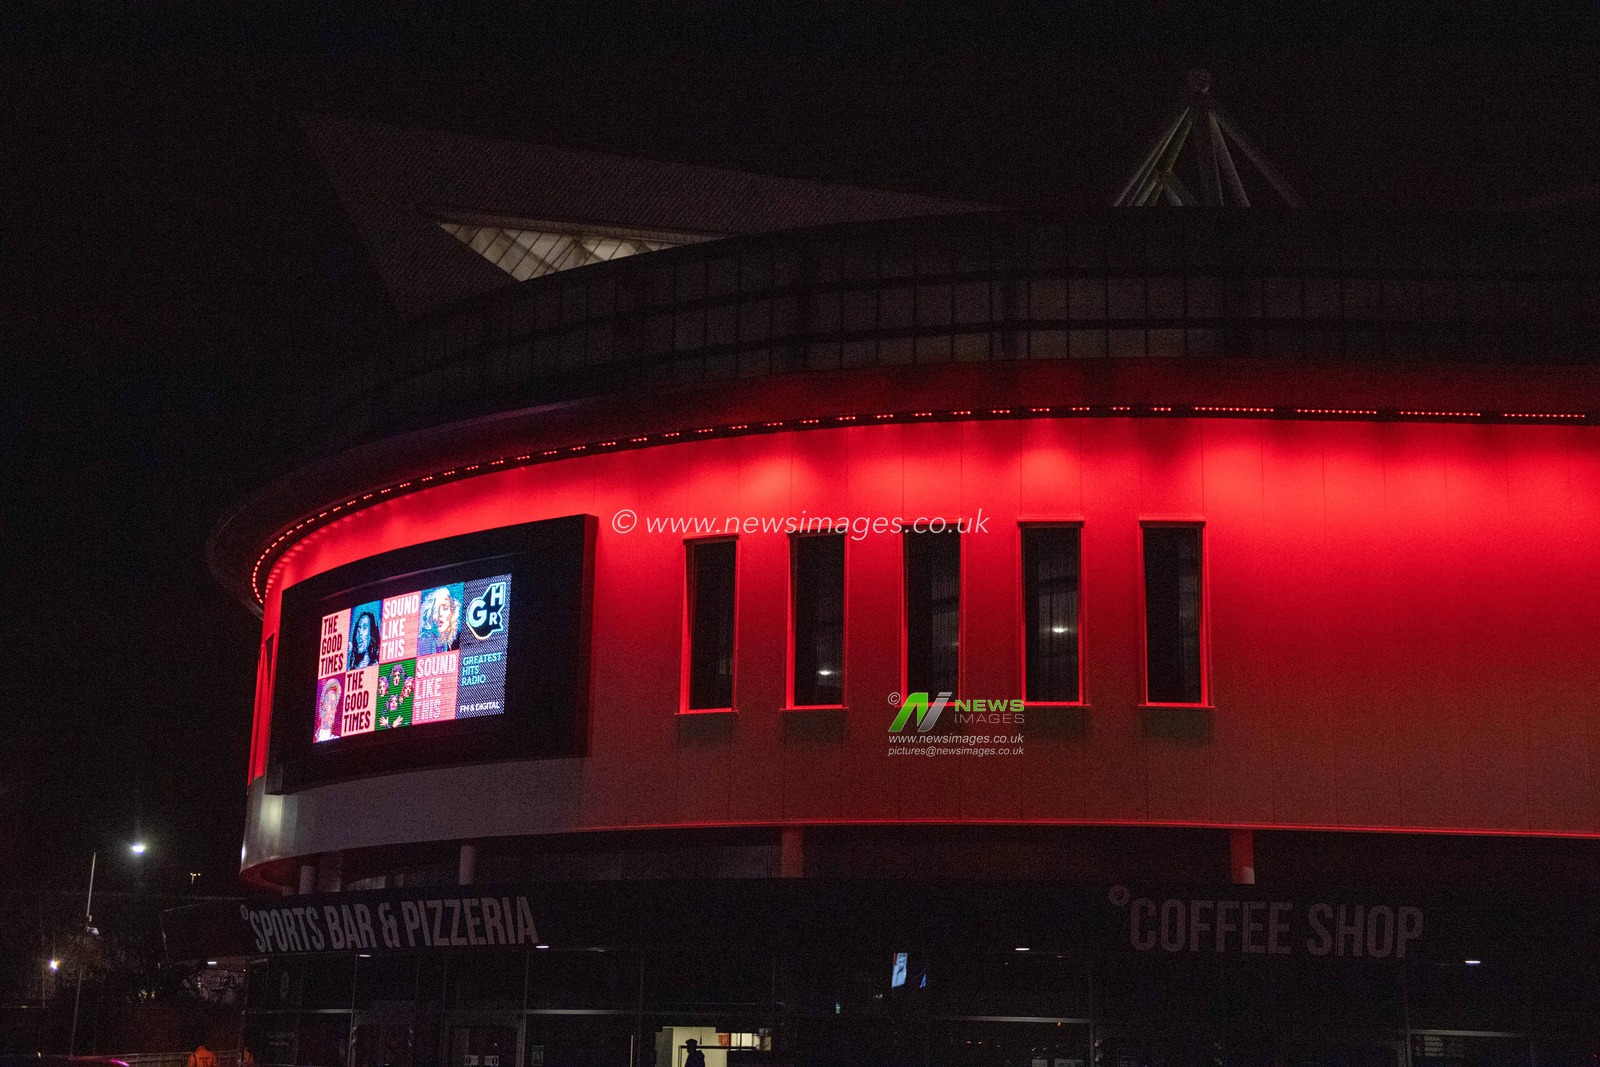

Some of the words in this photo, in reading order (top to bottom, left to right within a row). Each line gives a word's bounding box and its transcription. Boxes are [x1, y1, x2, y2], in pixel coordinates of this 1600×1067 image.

[383, 594, 420, 619] SOUND
[323, 615, 339, 636] THE
[382, 618, 406, 640] LIKE
[321, 634, 343, 654] GOOD
[381, 639, 405, 661] THIS
[320, 652, 344, 677] TIMES
[416, 654, 457, 678] SOUND
[462, 652, 503, 666] GREATEST
[346, 670, 365, 692] THE
[461, 674, 487, 687] RADIO
[462, 665, 480, 677] HITS
[415, 677, 443, 700] LIKE
[344, 690, 370, 713] GOOD
[414, 699, 441, 721] THIS
[343, 711, 371, 733] TIMES
[250, 907, 325, 952] SPORTS
[323, 904, 378, 949] BAR
[378, 902, 401, 948] &
[401, 897, 539, 947] PIZZERIA
[1130, 899, 1293, 954] COFFEE
[1306, 902, 1424, 957] SHOP
